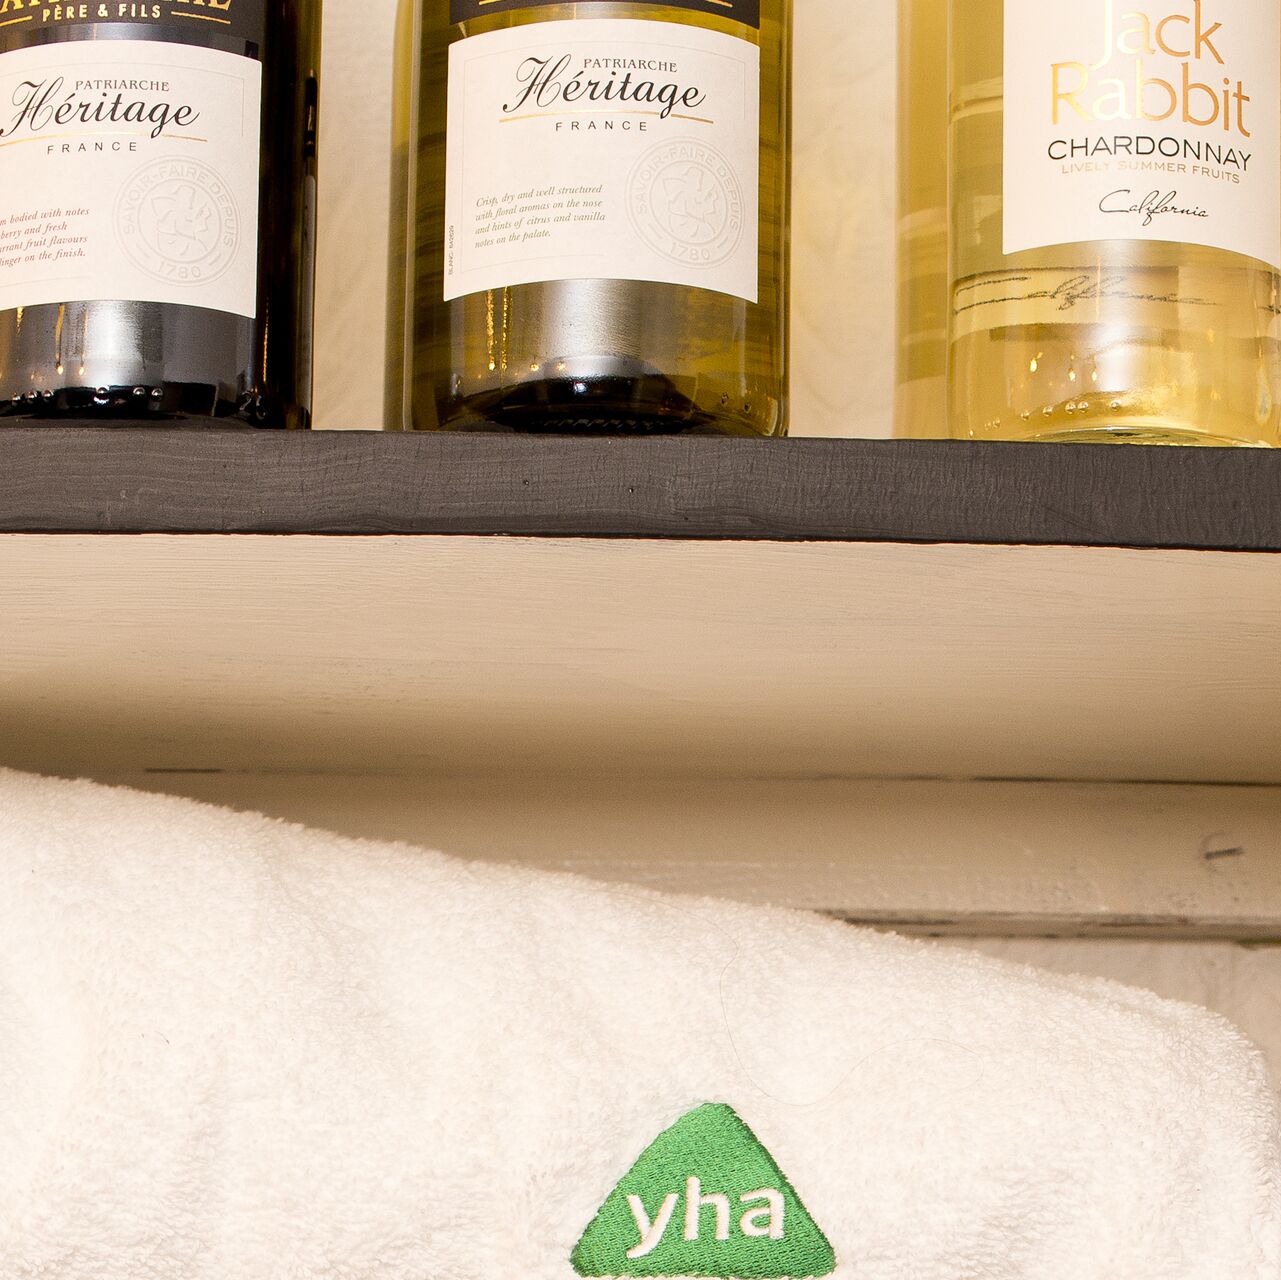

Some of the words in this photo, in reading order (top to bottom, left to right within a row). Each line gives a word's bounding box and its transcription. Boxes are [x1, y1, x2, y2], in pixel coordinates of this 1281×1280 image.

[43, 4, 87, 22] PÈRE
[118, 4, 161, 19] FILS
[1094, 0, 1225, 70] Jack
[583, 57, 678, 73] PATRIARCHE
[75, 79, 170, 92] PATRIARCHE
[502, 53, 707, 119] Héritage
[1050, 58, 1251, 138] Rabbit
[0, 76, 200, 139] Héritage
[555, 119, 648, 133] FRANCE
[47, 141, 137, 155] FRANCE
[1047, 135, 1252, 171] CHARDONNAY
[1117, 160, 1187, 174] SUMMER
[1191, 165, 1241, 185] FRUITS
[517, 188, 534, 201] and
[536, 185, 556, 198] well
[557, 184, 604, 196] structured
[475, 209, 493, 222] with
[518, 202, 550, 214] aromas
[552, 201, 564, 209] on
[566, 197, 581, 209] the
[582, 198, 603, 208] nose
[1098, 188, 1209, 227] California
[625, 1175, 787, 1260] yha
